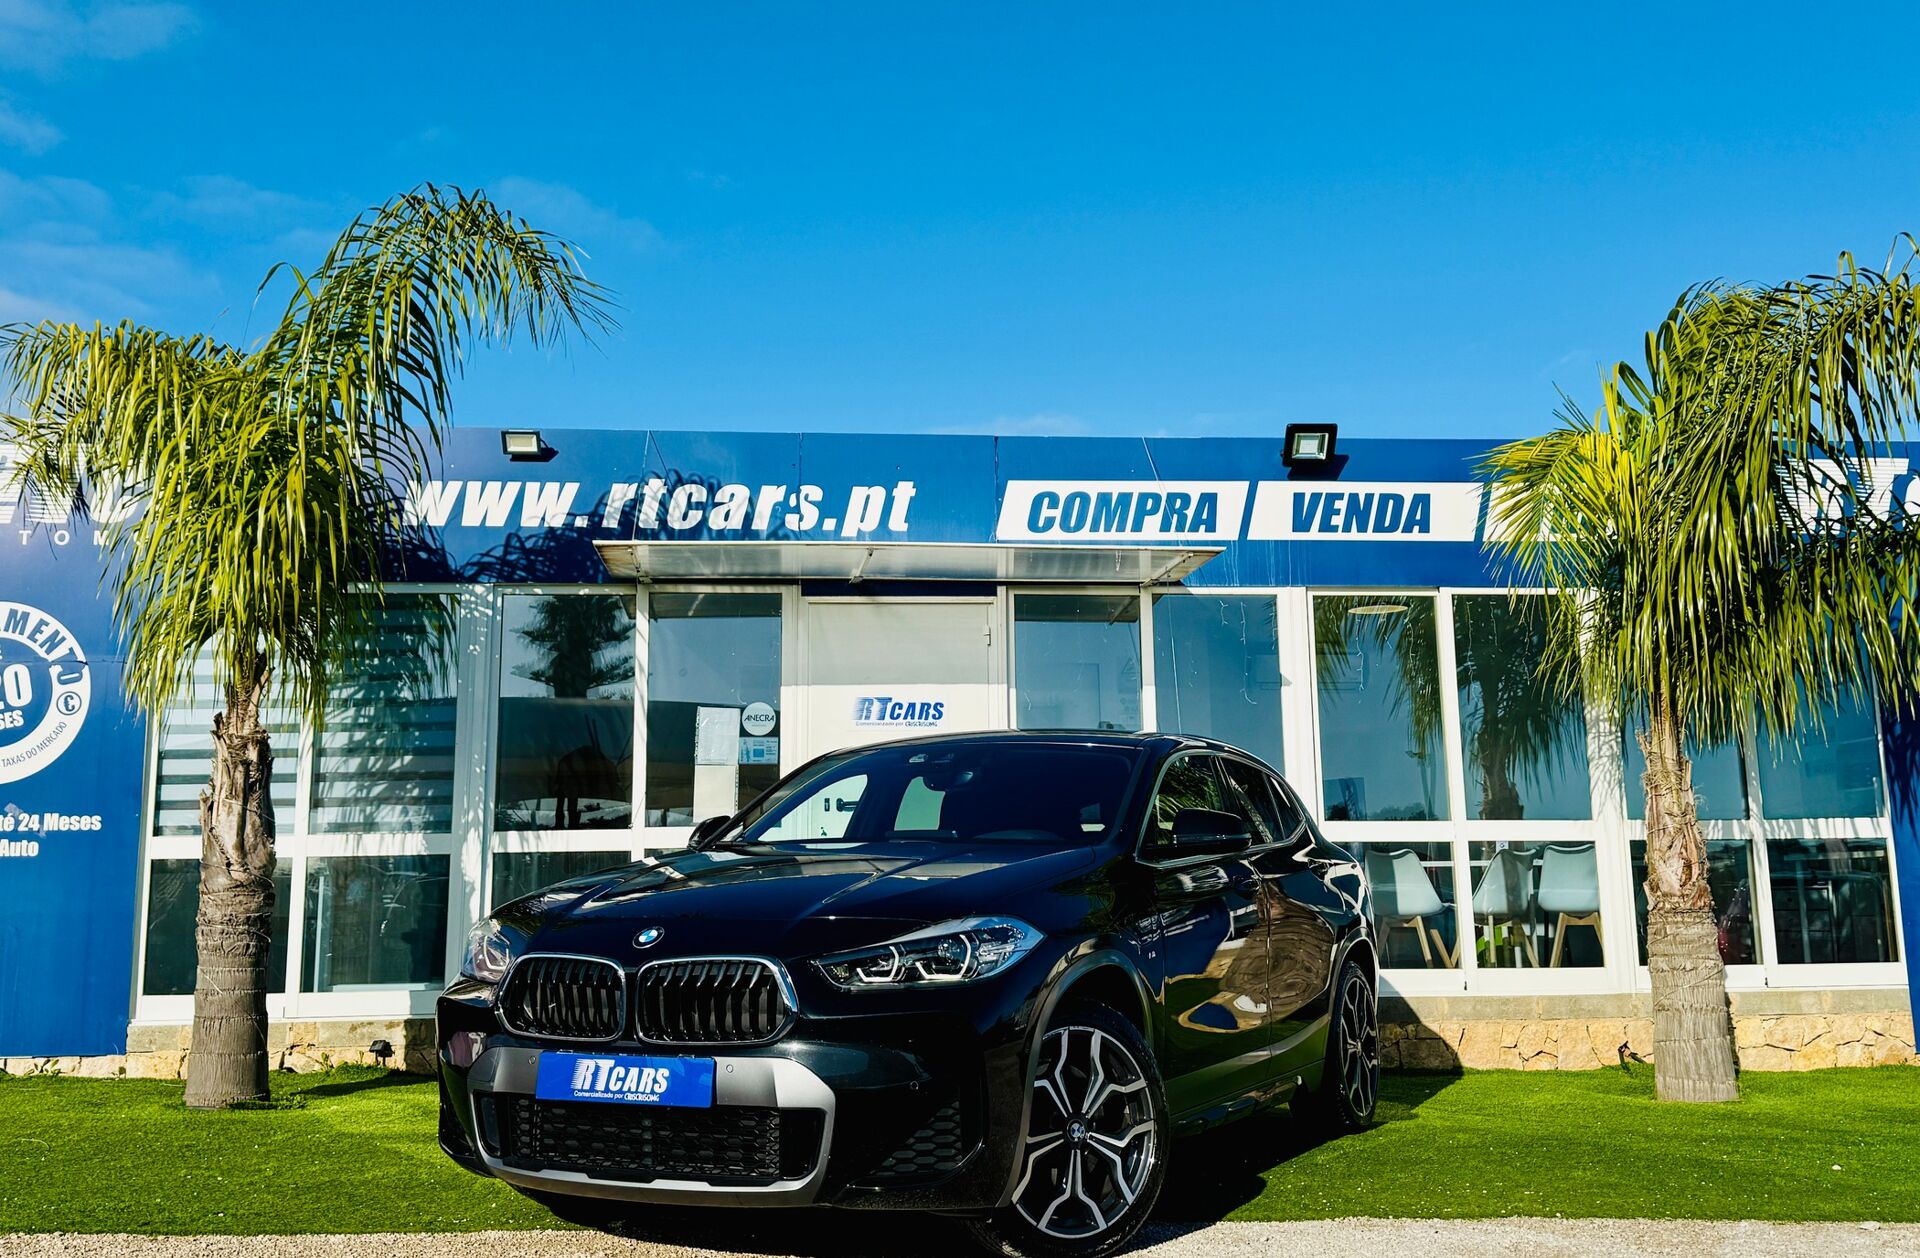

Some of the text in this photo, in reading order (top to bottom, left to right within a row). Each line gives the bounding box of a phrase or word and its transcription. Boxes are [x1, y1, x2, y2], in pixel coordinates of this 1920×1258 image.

[402, 478, 917, 538] www.rtcars.pt
[1027, 490, 1218, 534] COMPRA
[1291, 492, 1431, 534] VENDA
[744, 714, 775, 722] ANECRA
[2, 721, 67, 767] TAXAS DO MERCADO
[18, 813, 40, 831] 24
[43, 813, 102, 831] Meses
